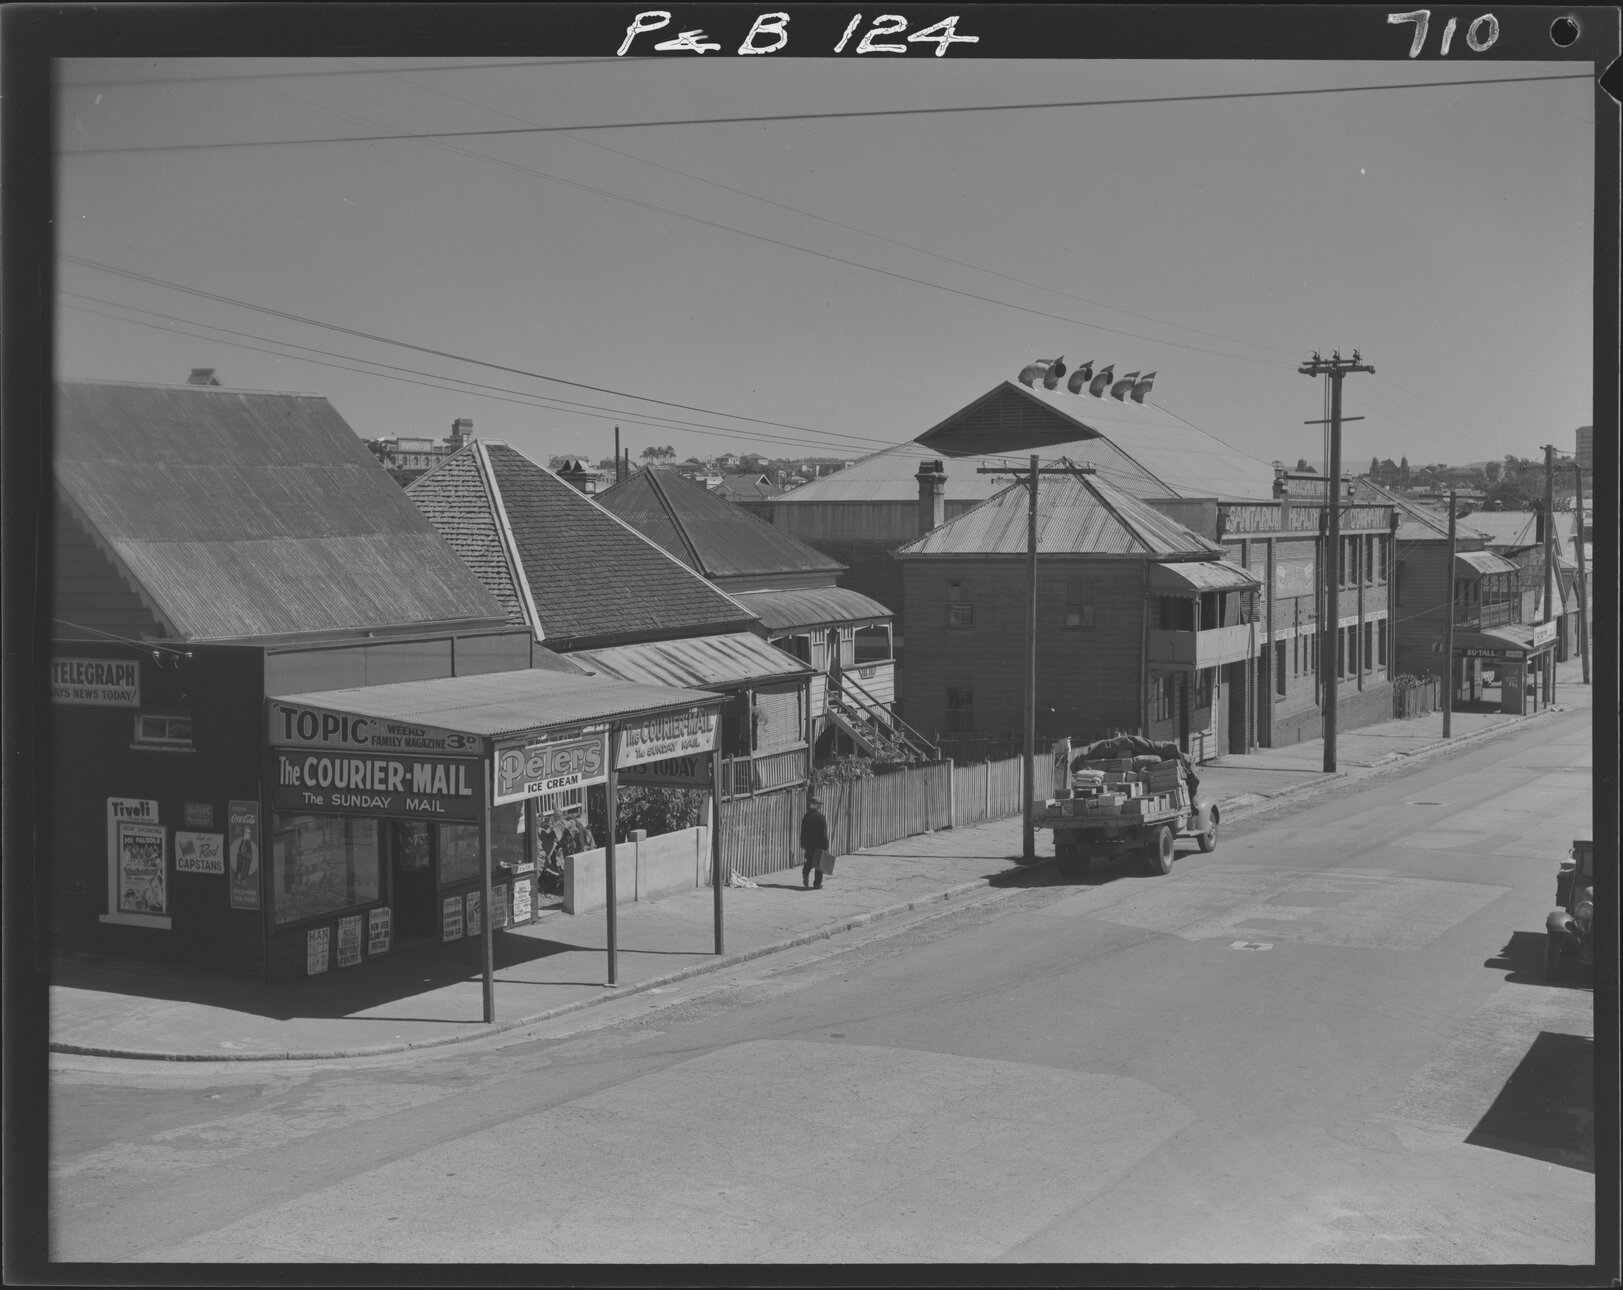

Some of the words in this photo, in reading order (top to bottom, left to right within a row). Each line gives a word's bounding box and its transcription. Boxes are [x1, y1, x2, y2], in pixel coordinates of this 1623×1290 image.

[617, 10, 671, 56] P
[737, 11, 790, 55] B
[833, 13, 980, 57] 124
[1386, 9, 1499, 58] 710
[50, 662, 135, 687] TELEGRAPH
[73, 688, 100, 700] NEWS
[101, 690, 137, 704] TODAY!
[386, 724, 426, 738] WEEKLY
[626, 723, 640, 748] The
[640, 711, 714, 745] COURIER-MAIL
[370, 735, 404, 750] FAMILY
[404, 736, 446, 750] MAGAZINE
[681, 738, 700, 751] MAIL
[499, 739, 602, 790] Peters
[279, 756, 300, 786] The
[302, 756, 473, 796] COURIER-MAIL
[528, 782, 543, 794] ICE
[546, 774, 578, 790] CREAM
[111, 801, 151, 817] Tivoli
[302, 792, 324, 805] The
[331, 794, 391, 809] SUNDAY
[405, 799, 446, 813] MAIL
[200, 843, 220, 858] Red
[178, 858, 223, 871] CAPSTANS
